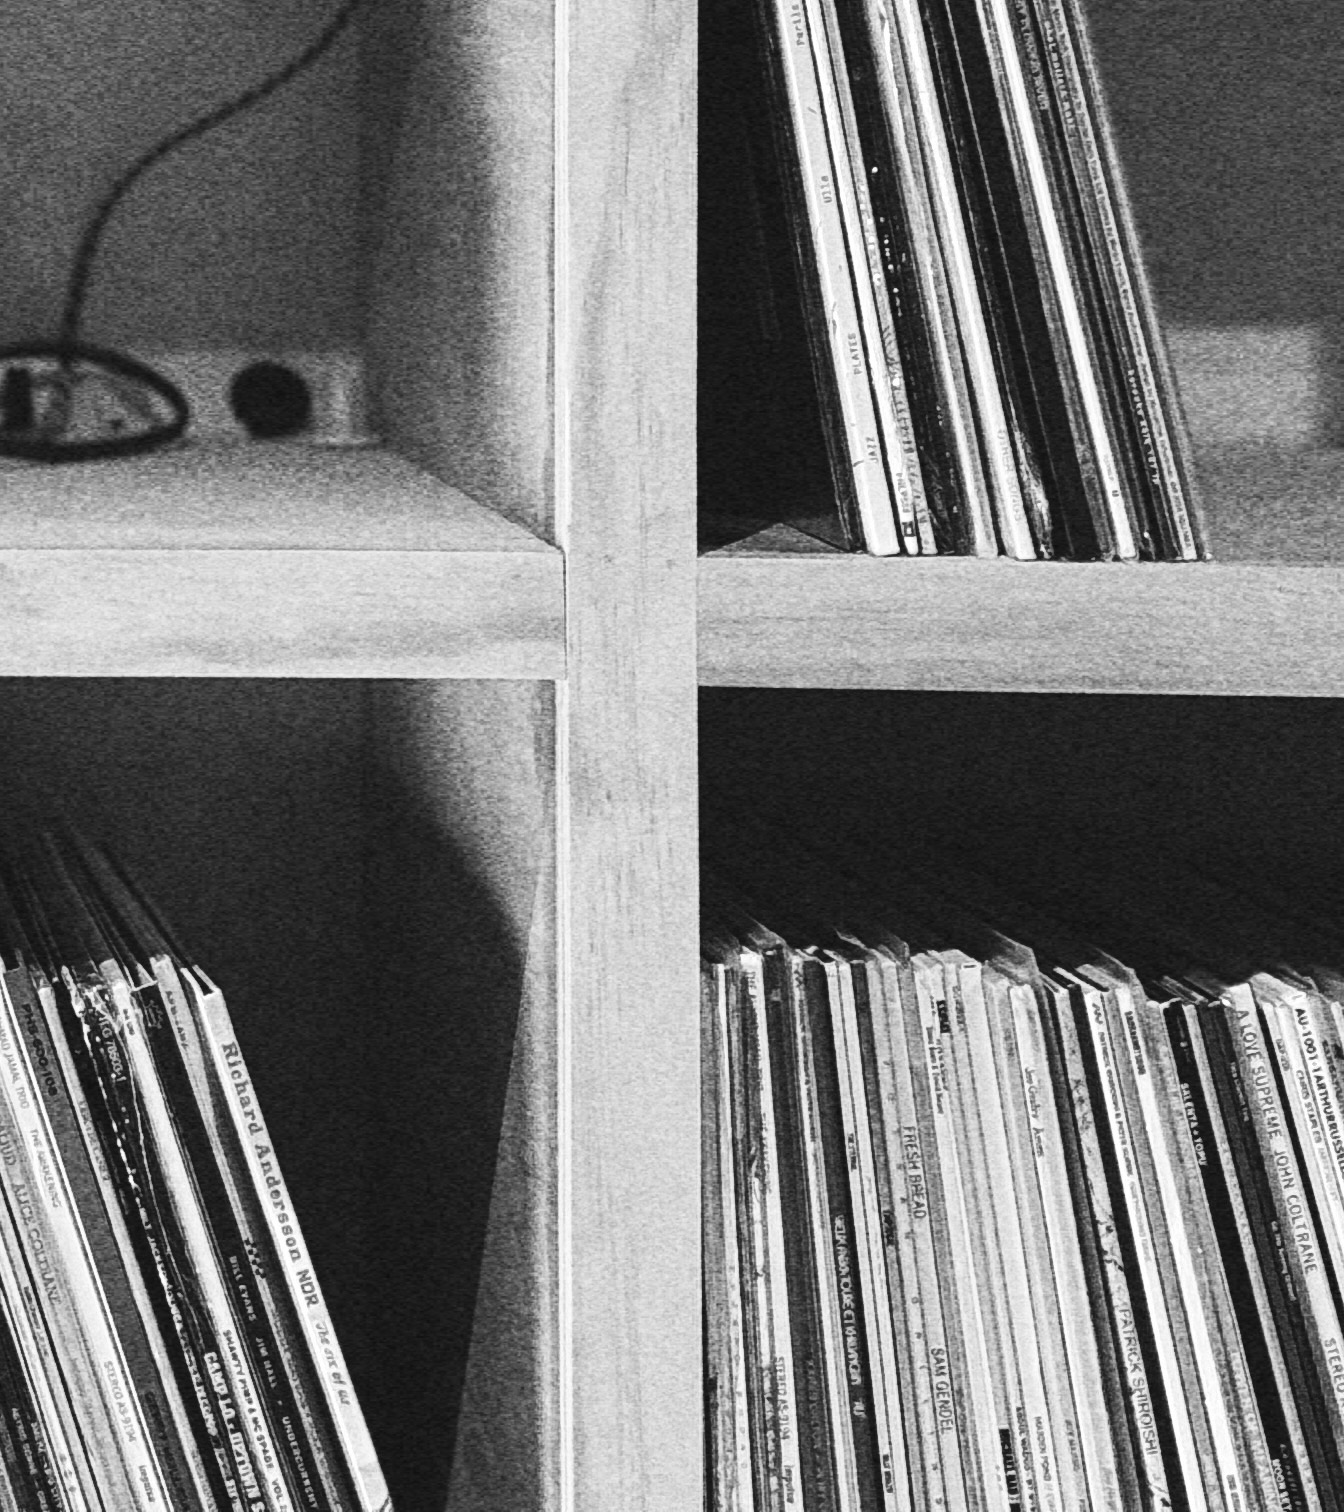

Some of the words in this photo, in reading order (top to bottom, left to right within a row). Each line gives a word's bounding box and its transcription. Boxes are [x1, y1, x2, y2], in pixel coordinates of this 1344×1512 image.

[818, 174, 833, 204] Ulla
[845, 330, 863, 375] PLATES
[864, 434, 879, 464] JAZZ
[1233, 1008, 1251, 1020] A
[1237, 1023, 1262, 1062] LOVE
[2, 1051, 23, 1086] JAMAL
[14, 1086, 31, 1111] TRIO
[220, 1040, 264, 1136] Richard
[1179, 1082, 1199, 1129] SALENTA
[1249, 1065, 1284, 1139] SUPREME
[26, 1127, 43, 1149] THE
[900, 1124, 921, 1171] FRESH
[907, 1172, 927, 1220] BREAD
[1272, 1148, 1296, 1189] JOHN
[1284, 1194, 1319, 1274] COLTRANE
[10, 1180, 37, 1227] ALICE
[25, 1227, 63, 1307] COLTRANE
[253, 1141, 305, 1263] Andersson
[295, 1268, 320, 1309] NDR
[228, 1254, 244, 1281] BILL
[237, 1282, 258, 1322] EVANS
[254, 1334, 269, 1357] JIM
[313, 1320, 332, 1347] The
[929, 1345, 947, 1377] SAM
[1116, 1307, 1143, 1374] PATRICK
[1130, 1376, 1158, 1455] SHIROISHI
[1323, 1337, 1344, 1393] STEREO
[202, 1350, 229, 1397] CAMP
[227, 1430, 262, 1500] UPTOWN
[221, 1327, 246, 1378] SHAWTY
[269, 1477, 287, 1504] VOL
[934, 1379, 955, 1436] GENDEL
[1270, 1458, 1287, 1490] MOON
